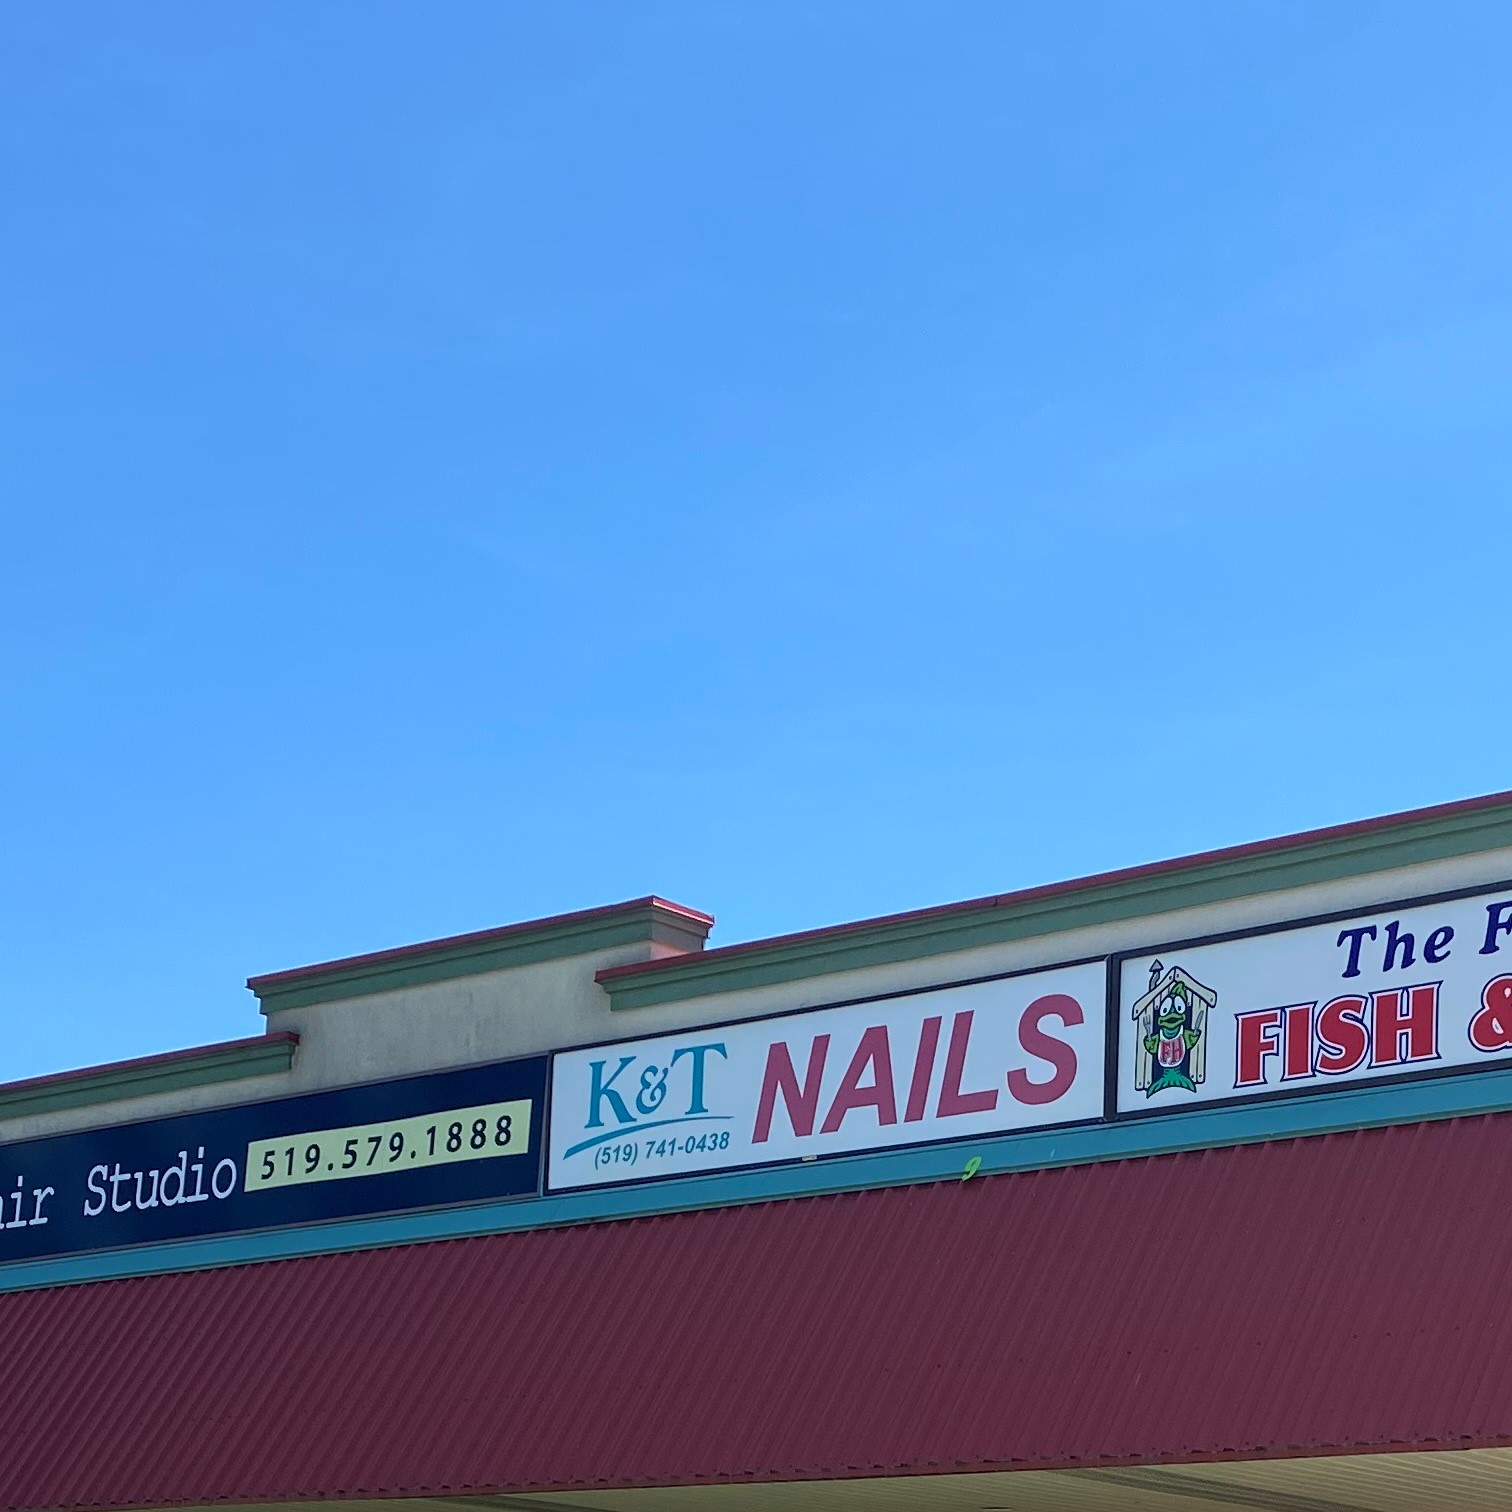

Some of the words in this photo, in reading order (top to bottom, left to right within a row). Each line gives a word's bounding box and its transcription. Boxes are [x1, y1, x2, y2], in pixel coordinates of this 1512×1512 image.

[1337, 918, 1452, 980] The
[584, 1042, 728, 1129] K&T
[751, 993, 1085, 1144] NAILS
[1233, 980, 1444, 1089] FISH
[260, 1115, 512, 1181] 519.579.1888
[594, 1142, 638, 1170] (519)
[645, 1131, 730, 1161] 741-0438
[0, 1175, 55, 1230] ir
[83, 1145, 237, 1216] Studio
